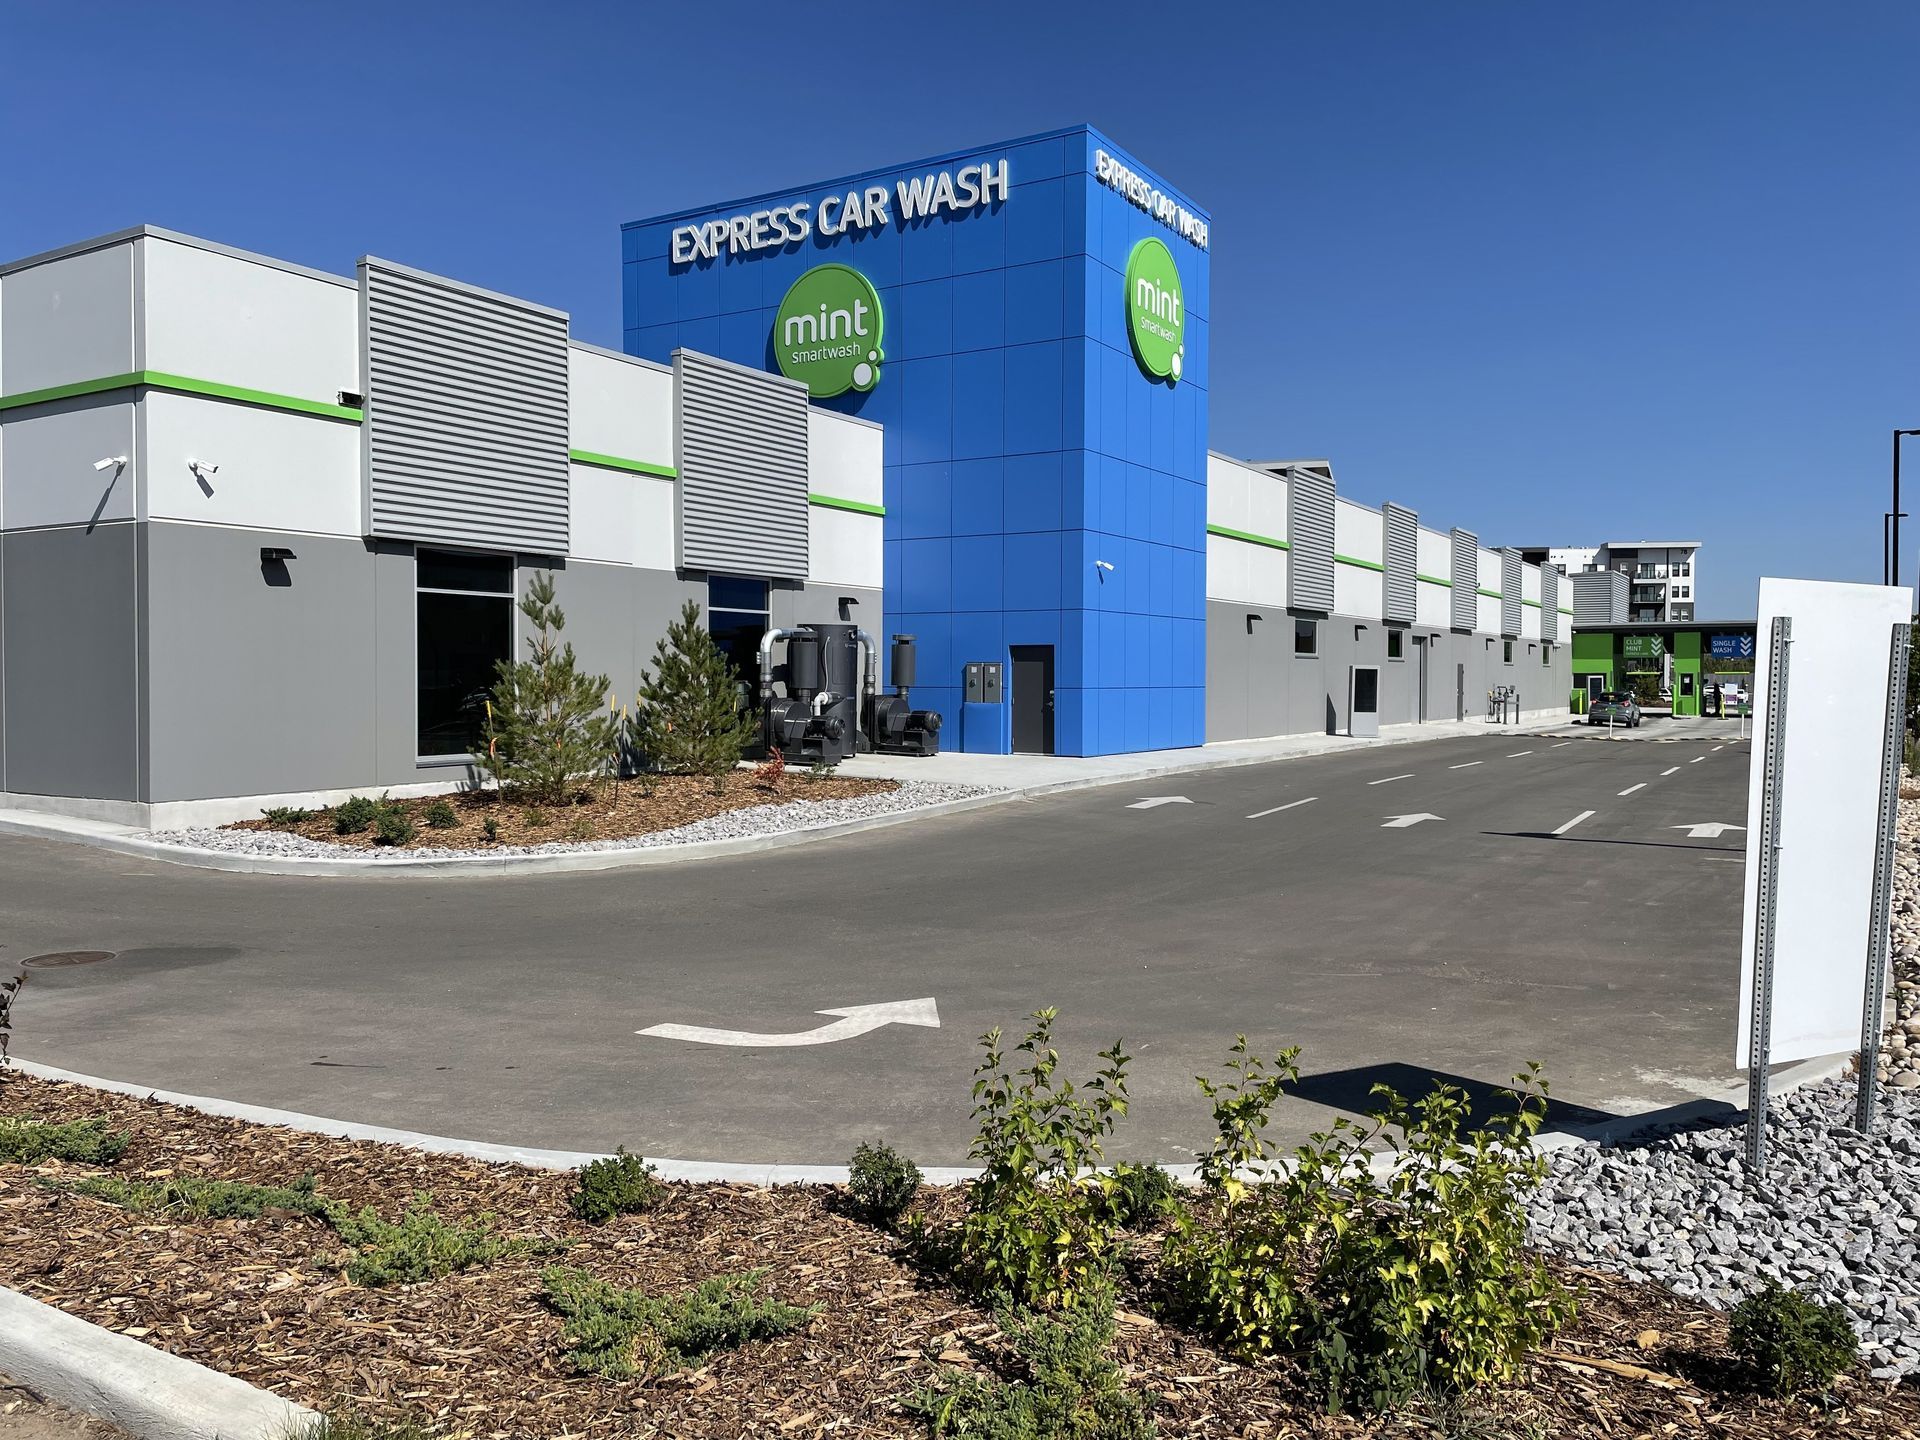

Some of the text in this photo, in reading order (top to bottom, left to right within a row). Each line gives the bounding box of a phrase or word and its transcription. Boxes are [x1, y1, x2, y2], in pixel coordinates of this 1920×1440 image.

[672, 158, 1009, 264] EXPRESS CAR WASH
[1096, 149, 1208, 248] EXPRESS CAR WASH
[784, 299, 869, 347] mint
[1137, 278, 1180, 327] mint
[791, 341, 861, 365] smartwash
[1140, 316, 1177, 344] smartwash
